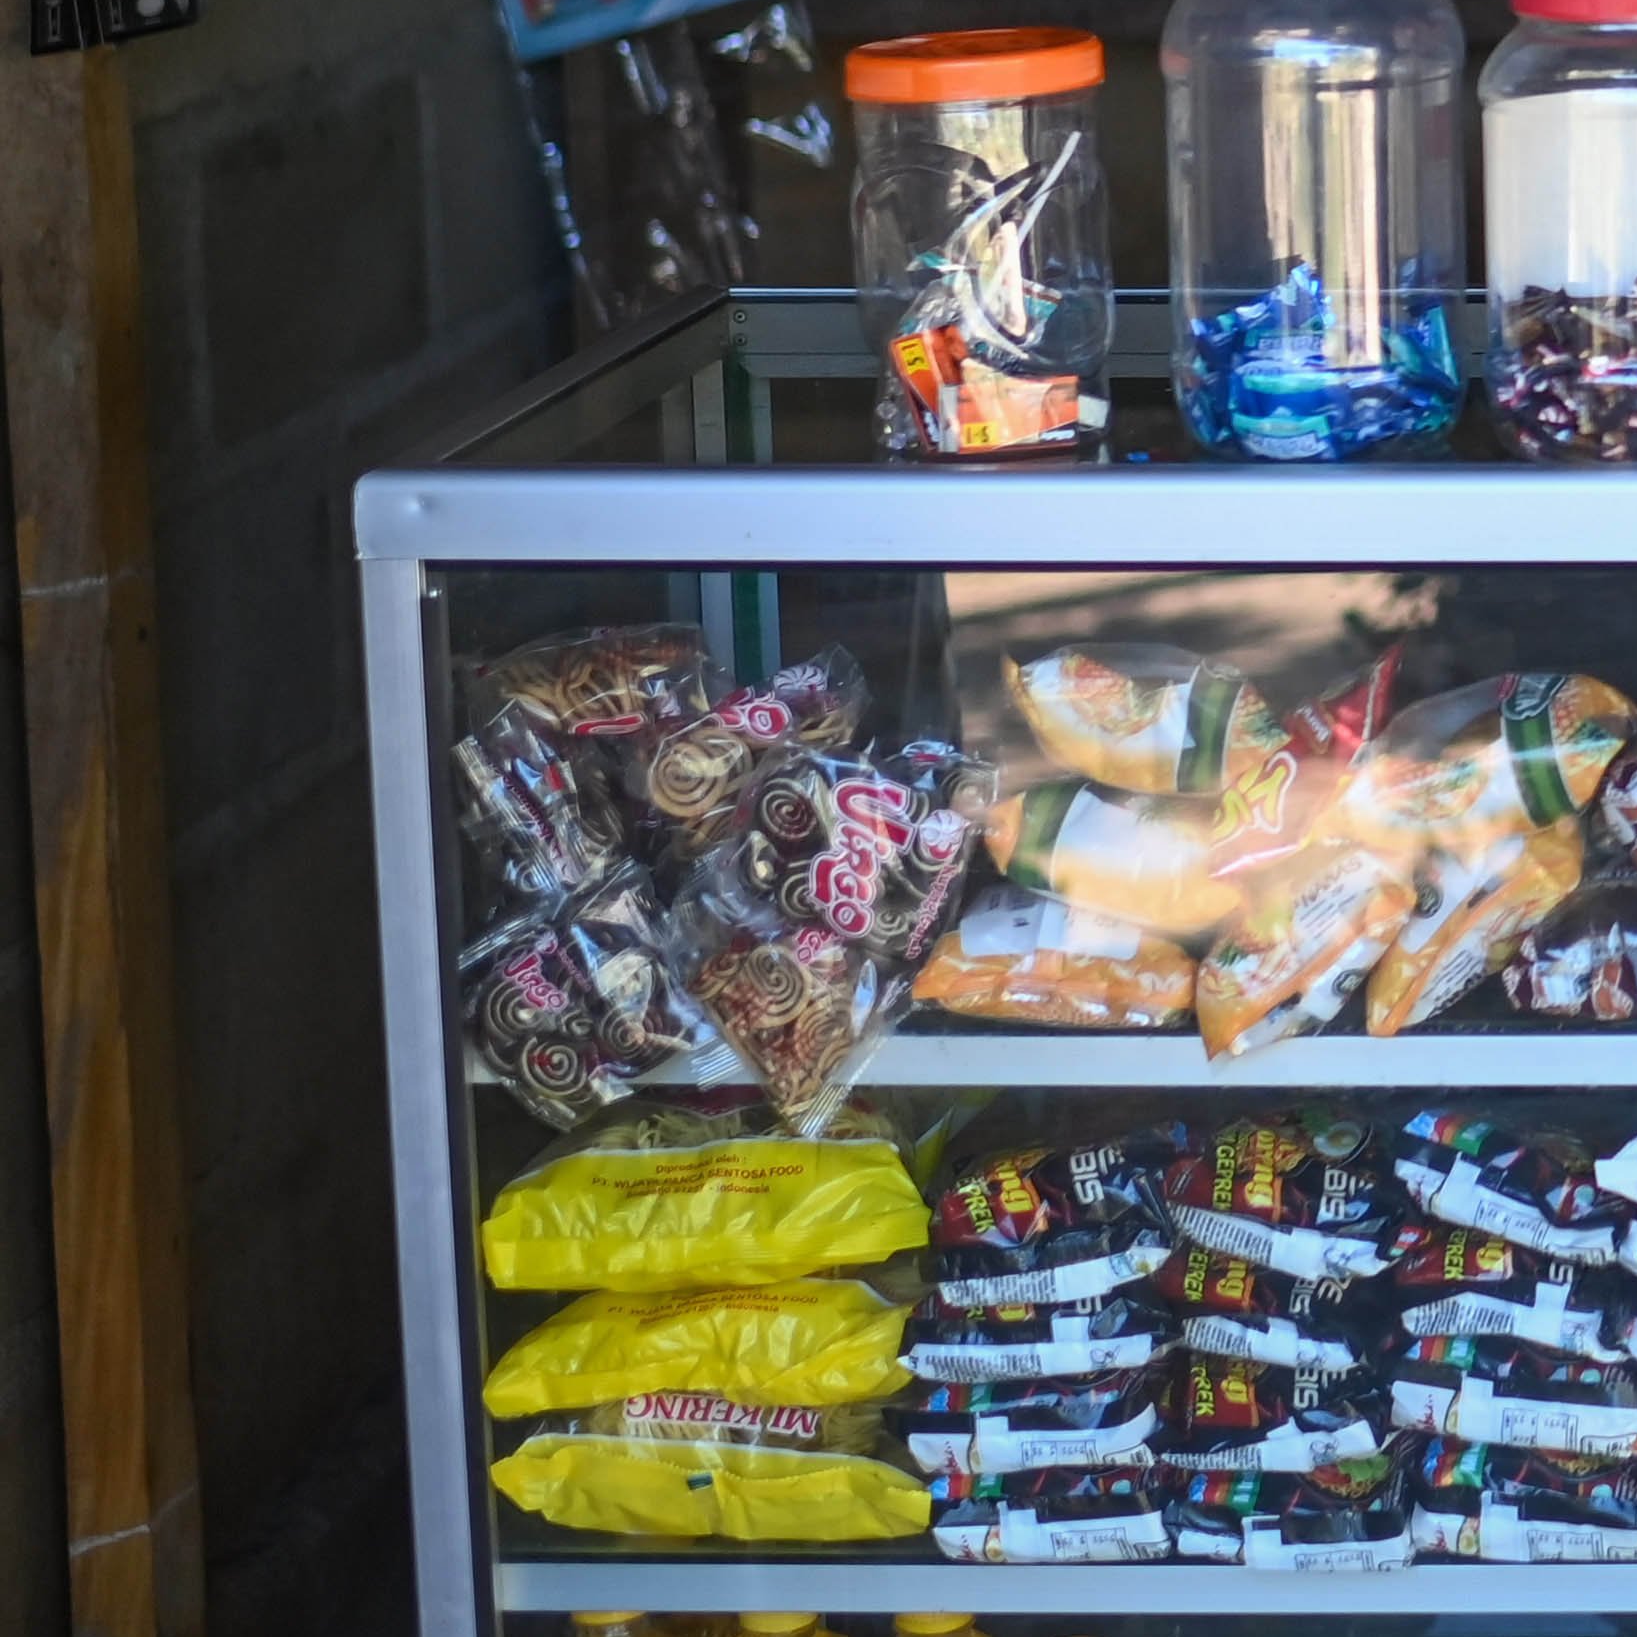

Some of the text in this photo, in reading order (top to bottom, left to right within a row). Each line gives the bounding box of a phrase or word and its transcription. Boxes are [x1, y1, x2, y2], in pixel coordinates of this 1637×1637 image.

[707, 1165, 768, 1180] SENTOSA
[769, 1163, 805, 1176] FOOD
[625, 1394, 823, 1439] MI KERING
